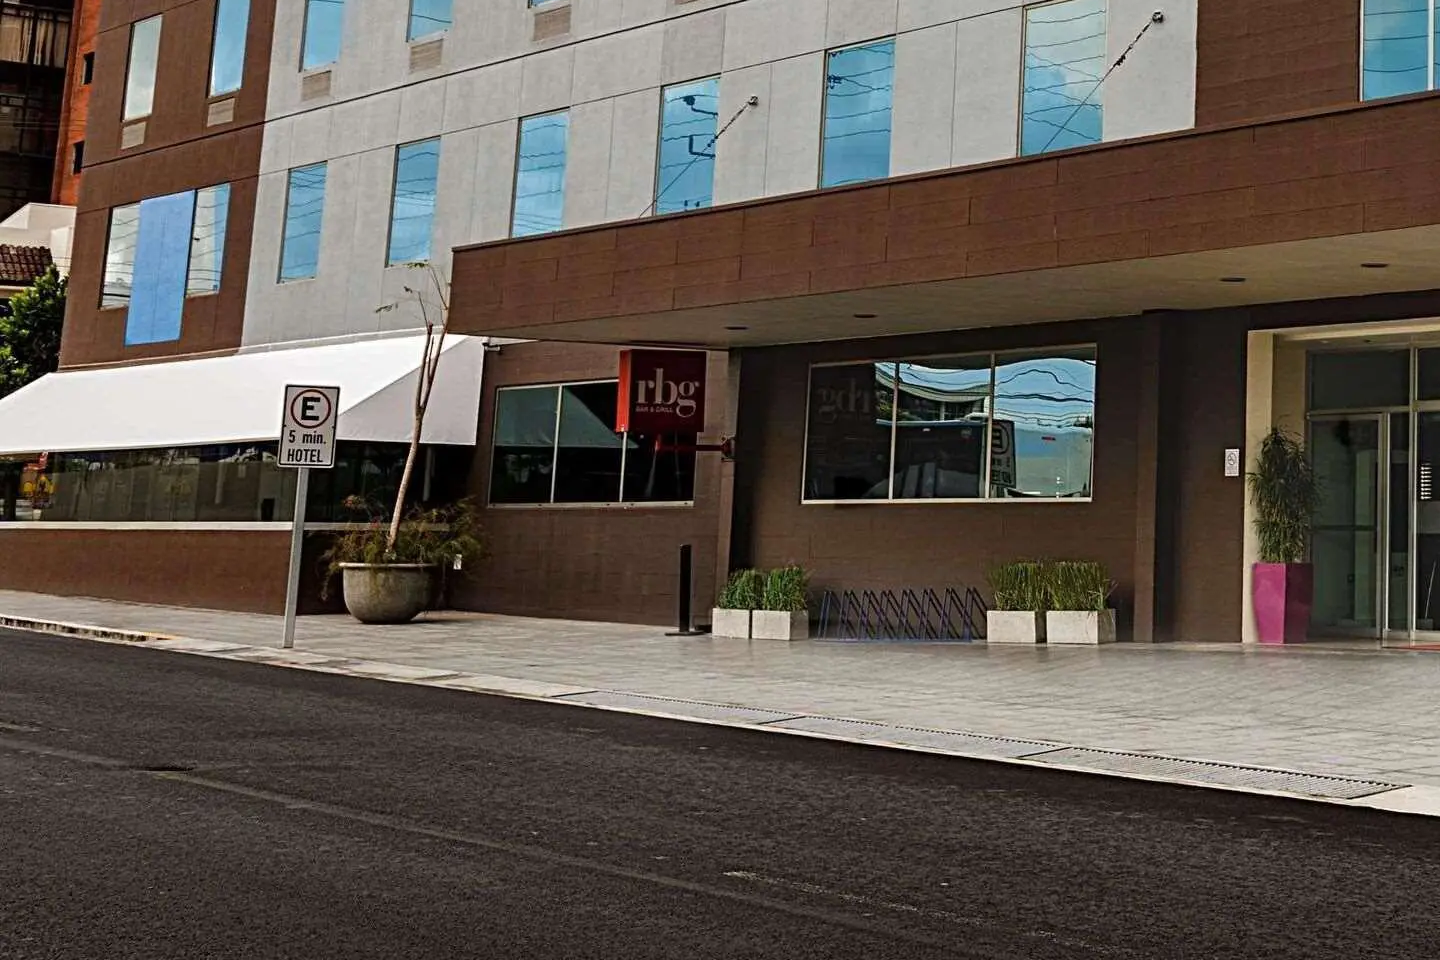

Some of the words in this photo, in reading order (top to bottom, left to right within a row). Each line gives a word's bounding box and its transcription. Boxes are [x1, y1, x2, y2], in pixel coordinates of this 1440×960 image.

[636, 368, 699, 418] rbg
[301, 396, 321, 421] E
[288, 430, 297, 443] 5
[302, 431, 326, 444] min.
[287, 448, 323, 462] HOTEL
